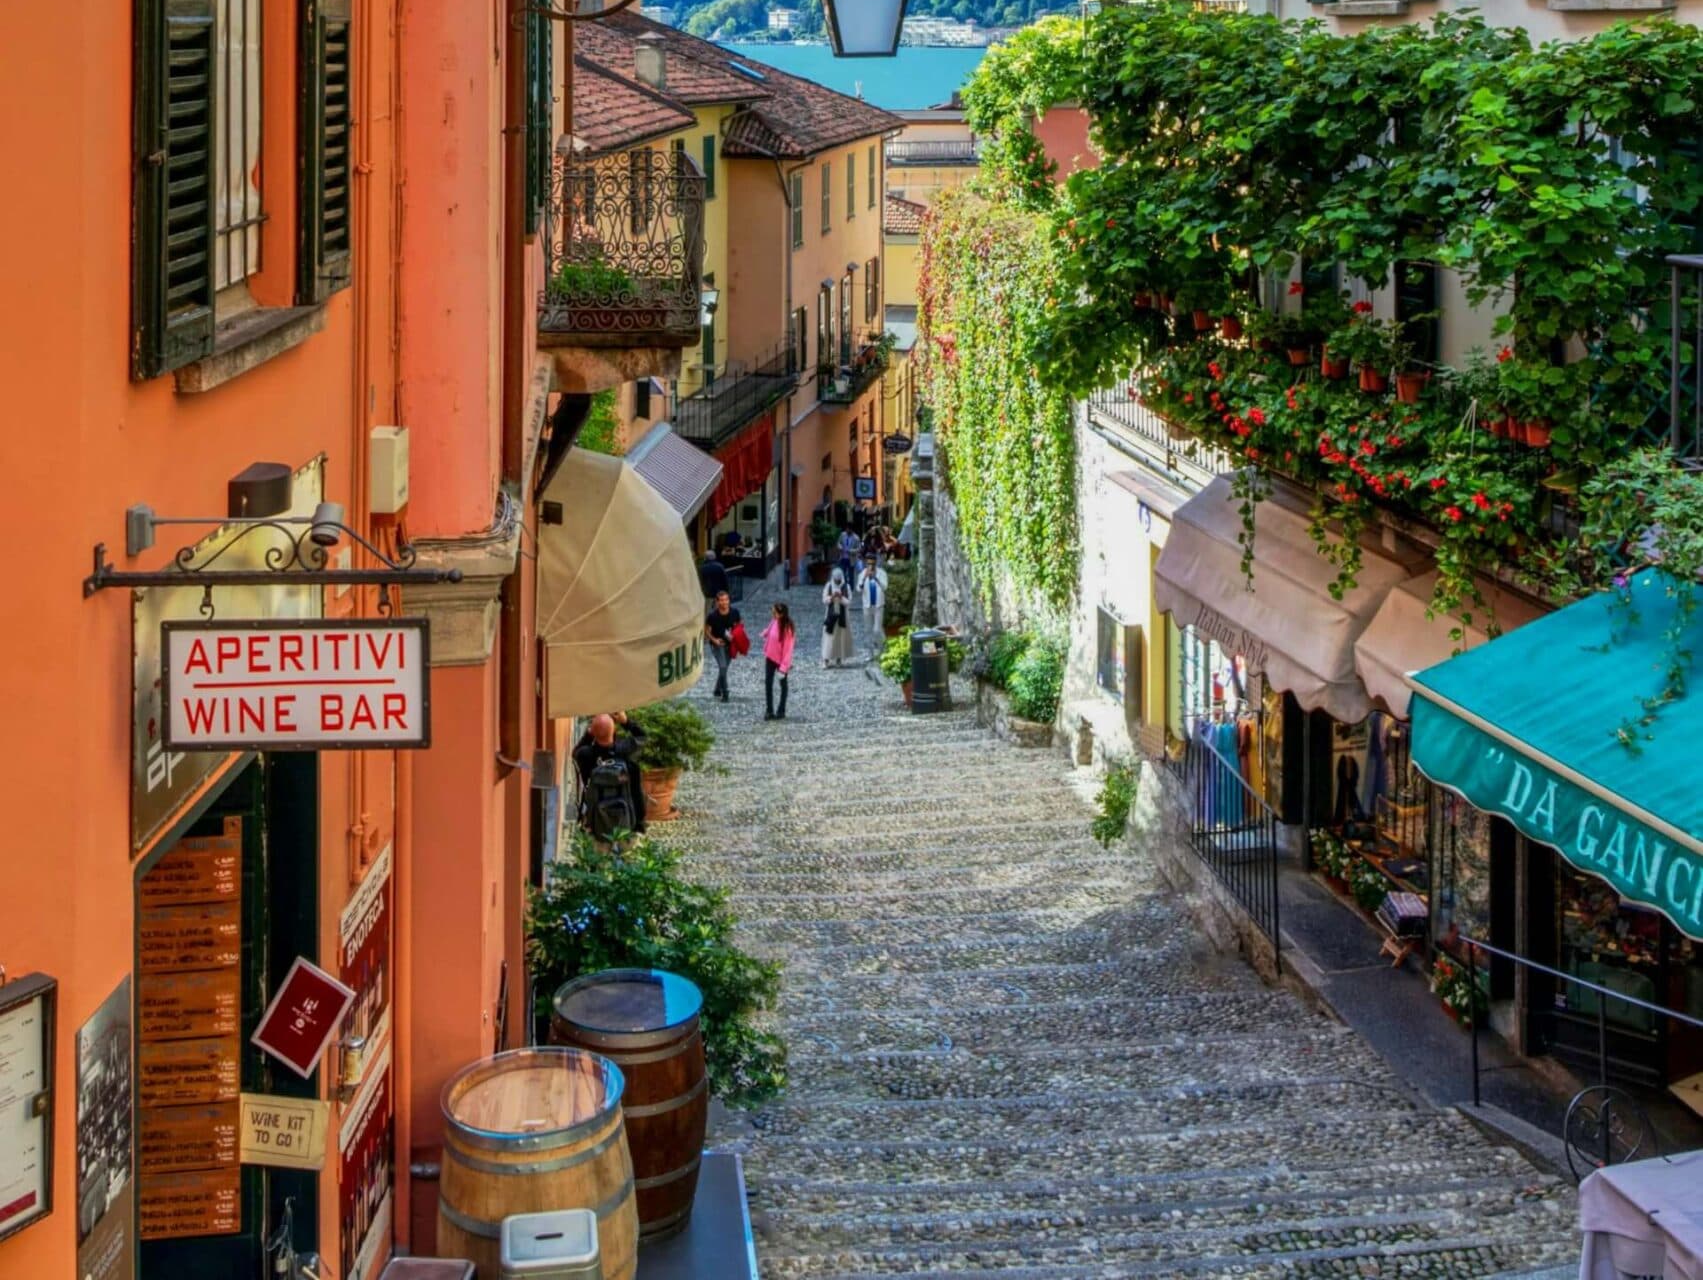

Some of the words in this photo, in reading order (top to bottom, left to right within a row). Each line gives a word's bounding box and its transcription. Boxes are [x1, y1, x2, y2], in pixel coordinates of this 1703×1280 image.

[184, 633, 405, 675] APERITIVI
[1195, 602, 1236, 649] Italian
[1237, 629, 1269, 668] Style
[183, 694, 297, 735] WINE
[320, 692, 408, 732] BAR
[346, 890, 385, 969] ENOTECA
[255, 1129, 270, 1145] TO
[276, 1132, 292, 1148] GO
